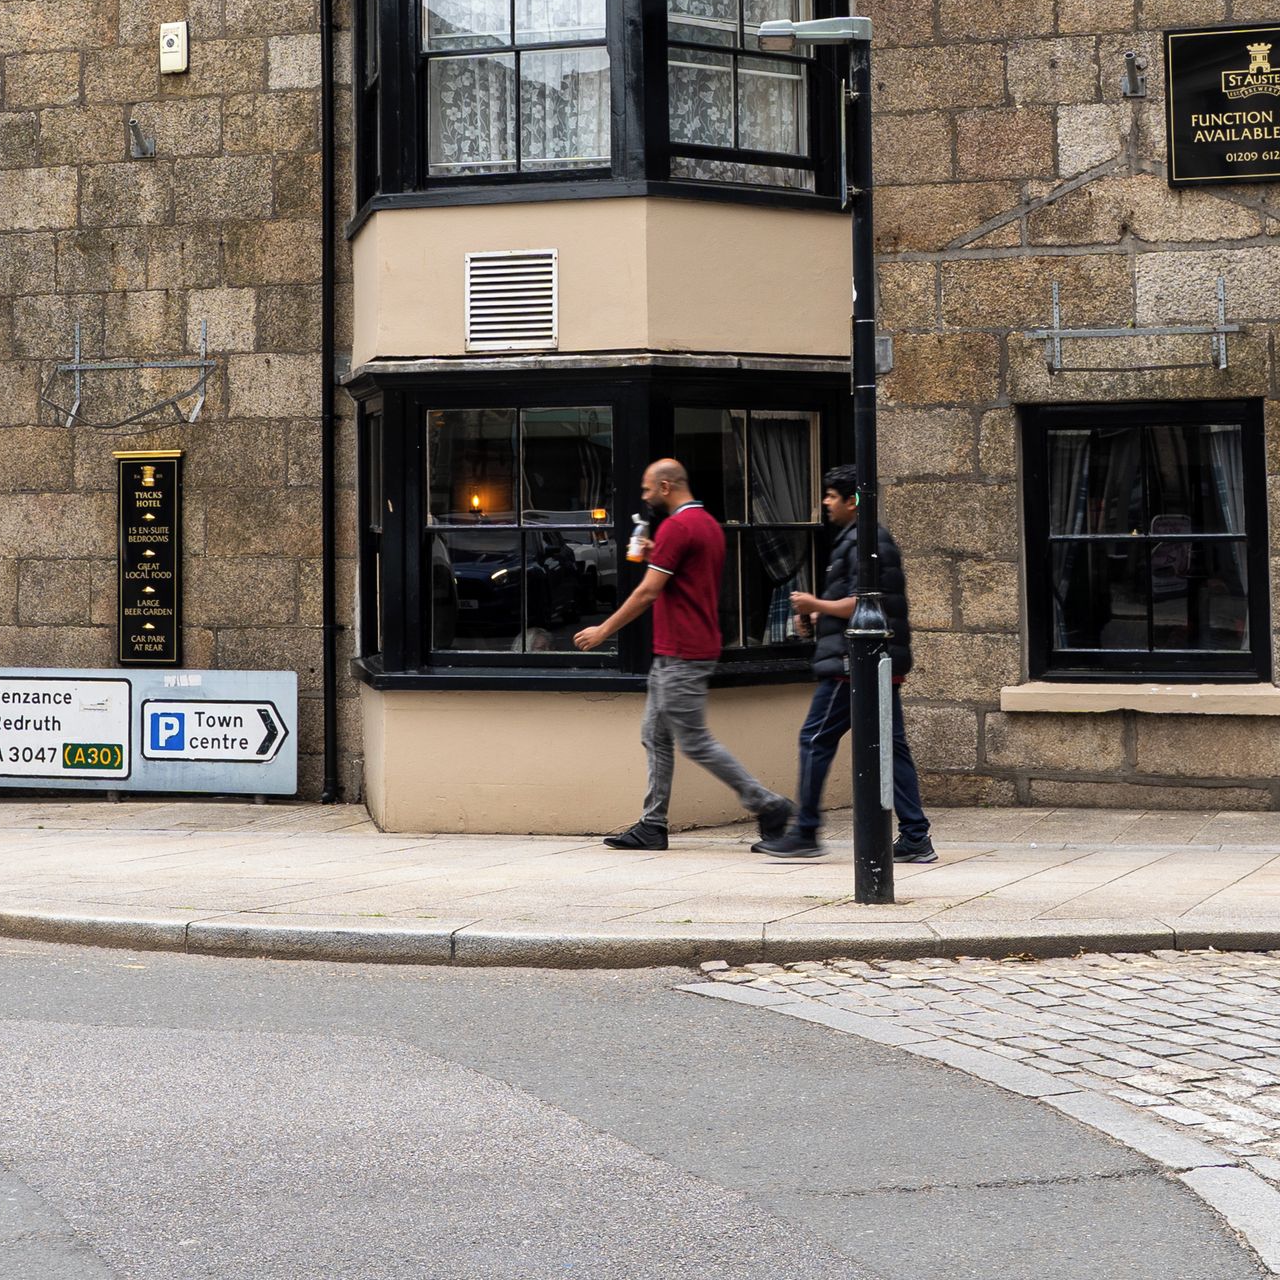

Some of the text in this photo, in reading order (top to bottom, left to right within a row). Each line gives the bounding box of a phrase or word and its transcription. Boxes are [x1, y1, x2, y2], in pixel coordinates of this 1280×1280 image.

[1244, 86, 1279, 96] BREWERY
[1191, 110, 1274, 127] FUNCTION
[1225, 151, 1258, 163] 01209
[134, 491, 163, 499] TYACKS
[136, 500, 161, 508] HOTEL
[138, 526, 170, 534] EN-SUITE
[128, 535, 169, 543] BEDROOMS
[137, 562, 160, 570] GREAT
[125, 569, 172, 579] LOCAL FOOD
[137, 599, 160, 607] LARGE
[124, 607, 173, 616] BEER GARDEN
[130, 635, 166, 643] CAR PARK
[133, 644, 164, 652] AT REAR
[194, 711, 244, 729] Town
[158, 716, 180, 748] P
[189, 734, 249, 751] centre
[62, 744, 122, 768] (A30)
